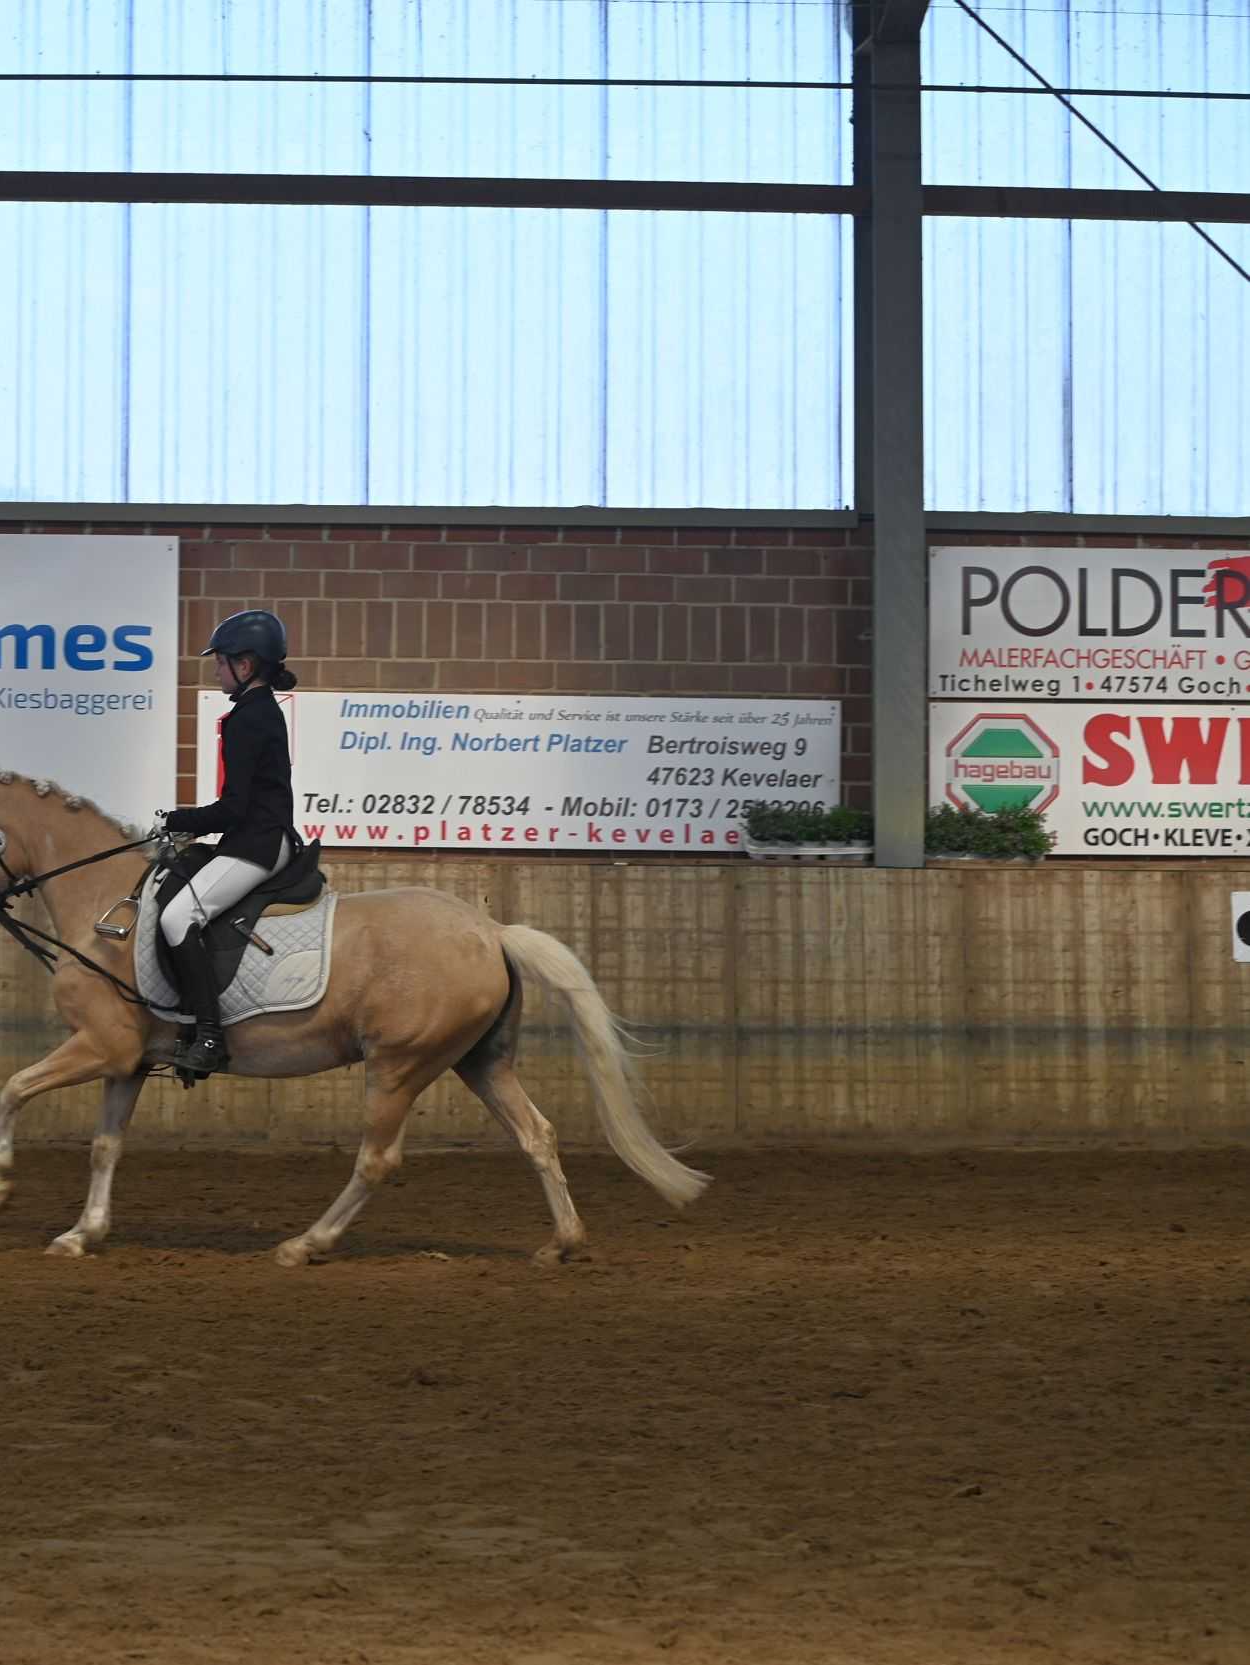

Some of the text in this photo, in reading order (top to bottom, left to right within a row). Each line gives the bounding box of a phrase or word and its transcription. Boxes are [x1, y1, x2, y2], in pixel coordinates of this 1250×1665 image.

[960, 565, 1250, 639] POLDER
[958, 643, 1207, 670] MALERFACHGESCHÄFT
[939, 674, 1241, 697] Tichelweg 1 47574 Goch
[340, 698, 471, 720] Immobilien
[473, 707, 834, 728] Qualität und Service ist unsere Stärke seit über 25 Jahren
[339, 731, 629, 756] Dipl. Ing. Norbert Platzer
[646, 735, 808, 761] Bertroisweg 9
[646, 766, 823, 789] 47623 Kevelaer
[953, 759, 1052, 783] hagebau
[303, 793, 354, 814] Tel.:
[361, 794, 436, 815] 02832
[458, 795, 531, 816] 78534
[560, 795, 638, 818] Mobil:
[645, 797, 703, 819] 0173
[1081, 797, 1250, 819] www.swert
[303, 820, 741, 845] www.platzer-kevelae
[1083, 827, 1150, 848] GOCH
[1164, 827, 1234, 848] KLEVE
